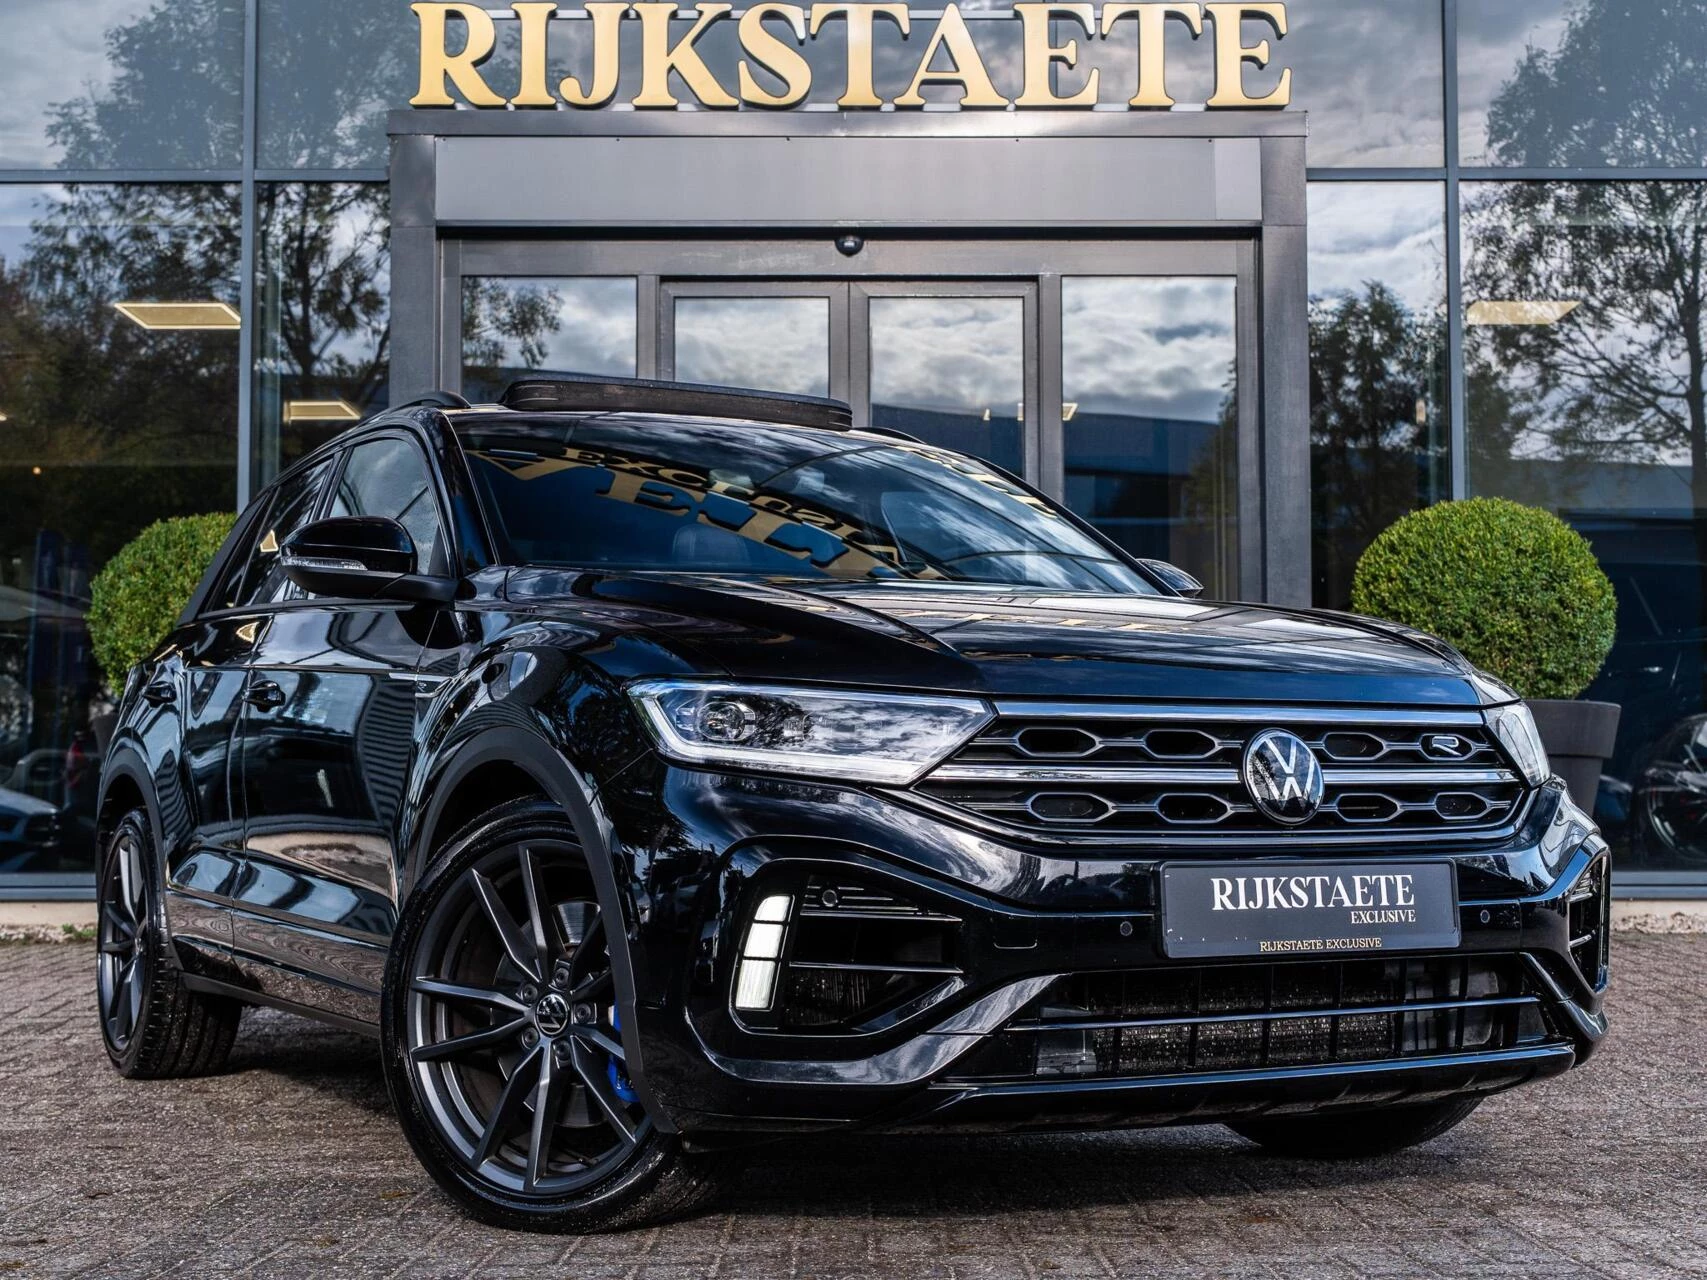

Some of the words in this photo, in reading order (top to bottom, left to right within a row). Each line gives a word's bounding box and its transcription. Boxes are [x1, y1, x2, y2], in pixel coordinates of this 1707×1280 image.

[408, 2, 1292, 110] RIJKSTAETE
[1431, 735, 1462, 757] R
[1210, 874, 1415, 911] RIJKSTAETE
[1350, 909, 1416, 924] EXCLUSIVE
[1259, 939, 1324, 952] RIJKSTAETE
[1326, 937, 1382, 950] EXCLUSIVE
